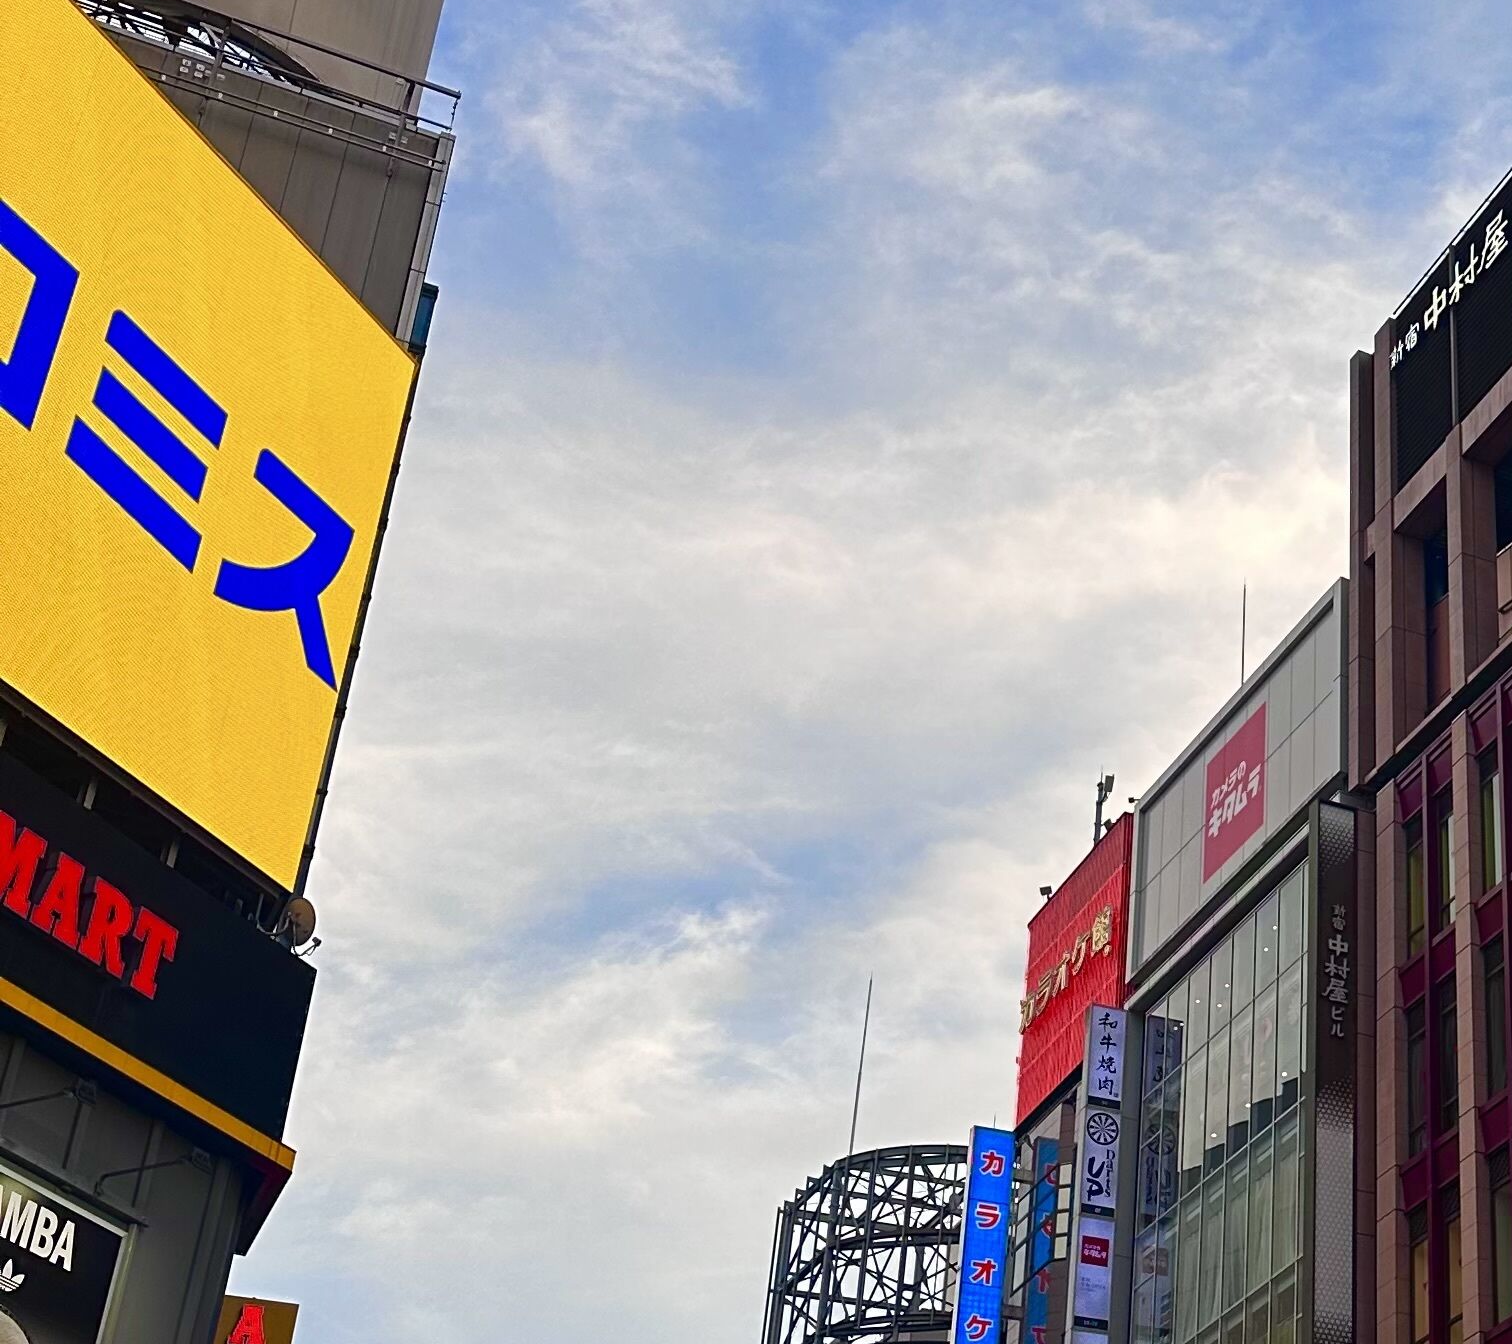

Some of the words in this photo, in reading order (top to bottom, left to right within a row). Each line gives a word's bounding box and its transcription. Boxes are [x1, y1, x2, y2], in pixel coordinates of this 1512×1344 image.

[1207, 763, 1262, 838] キタムラ
[1210, 760, 1247, 811] カメラの
[1019, 905, 1112, 1035] カラオケ館
[1098, 1012, 1118, 1096] 和牛焼肉
[0, 1184, 76, 1272] MBA
